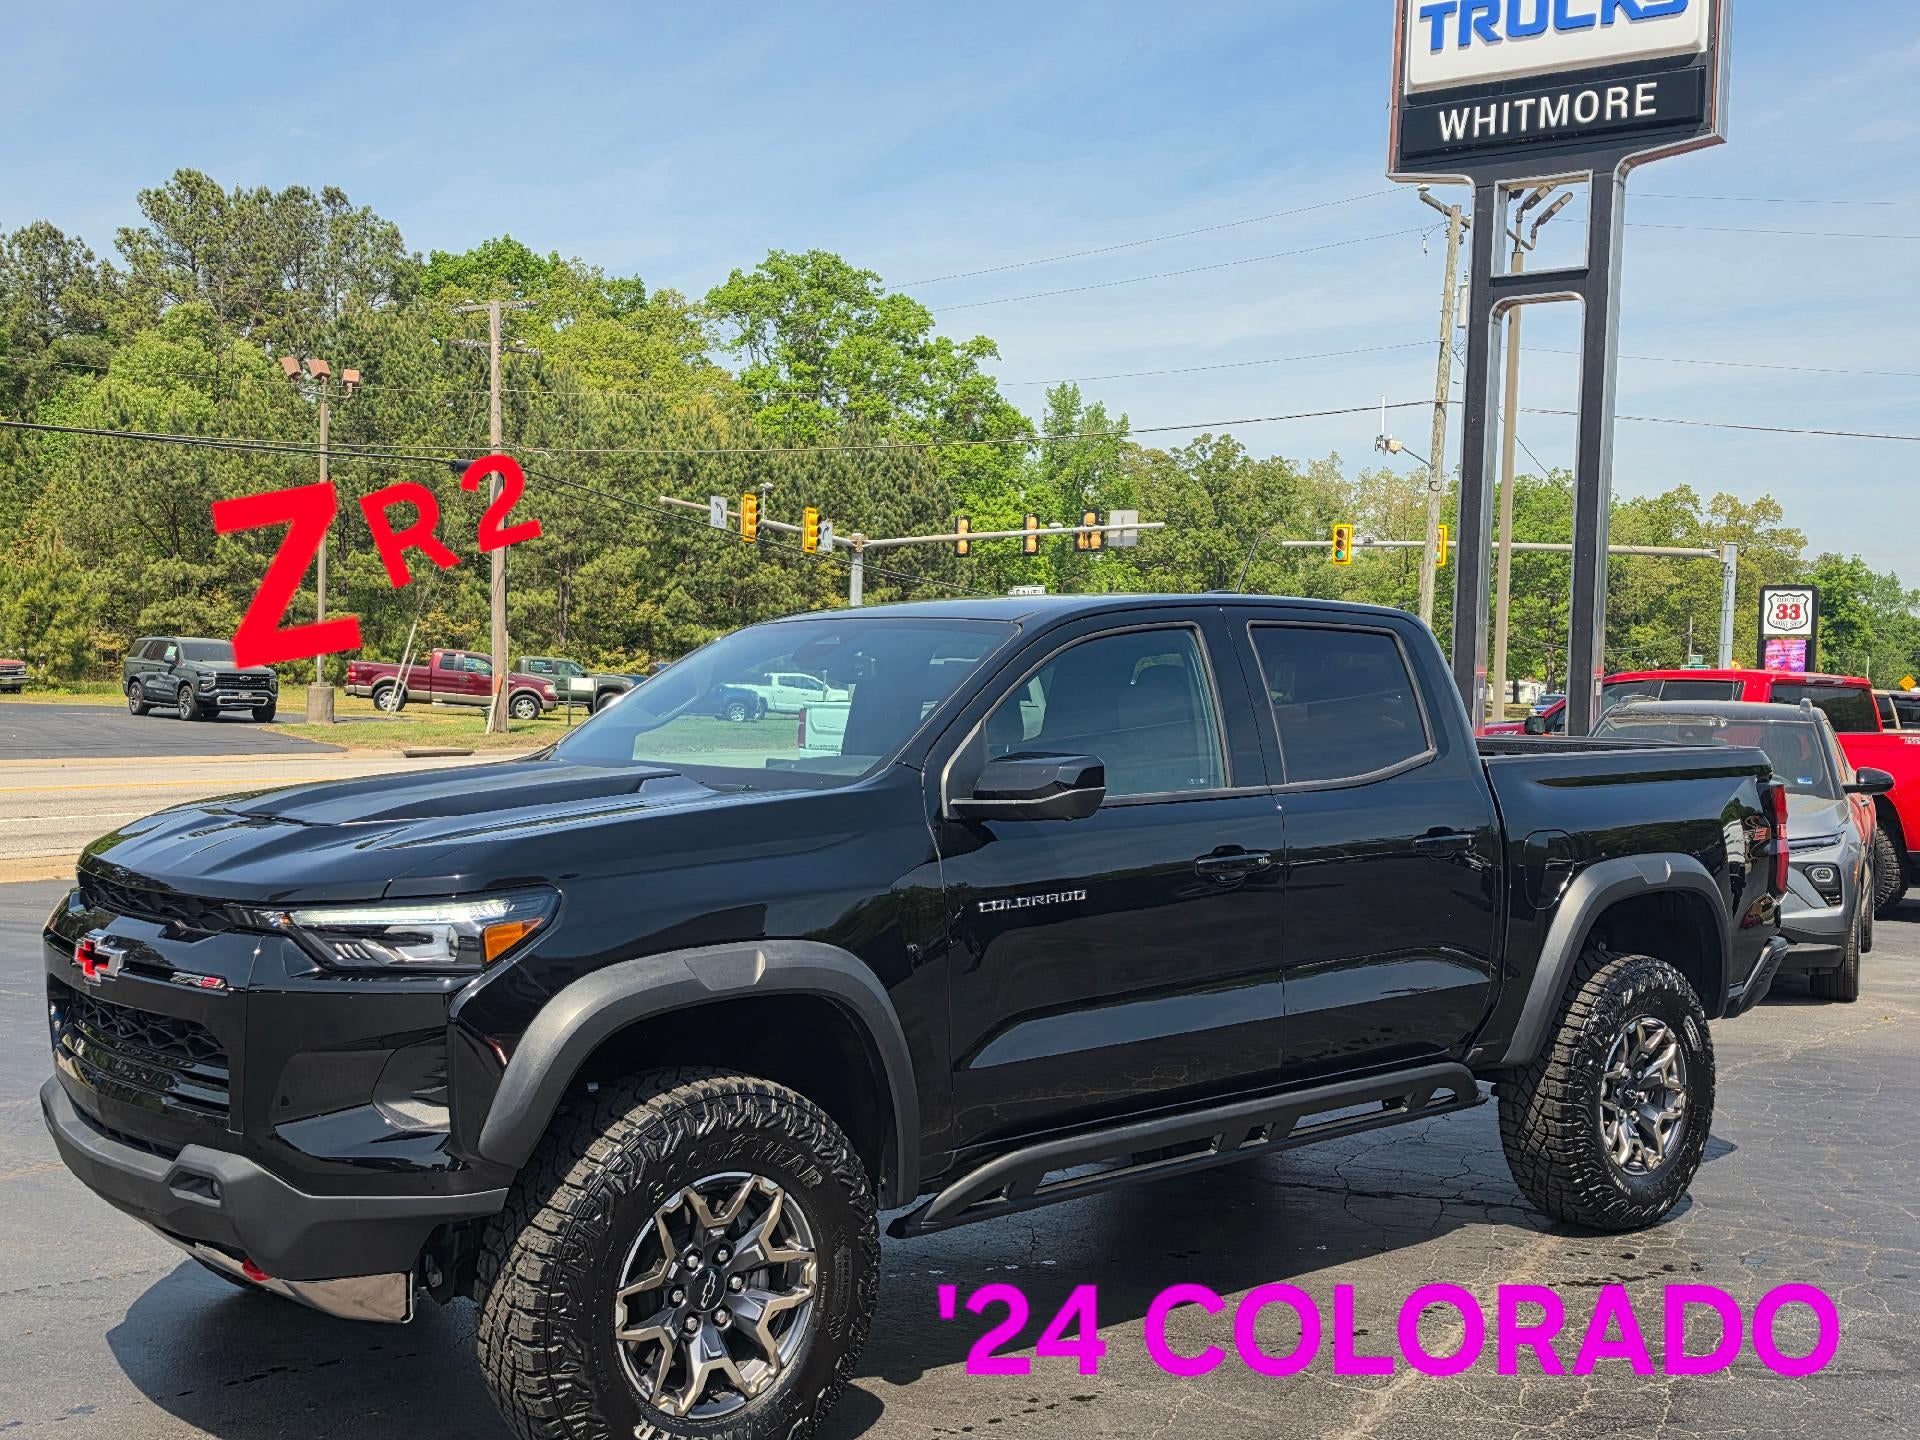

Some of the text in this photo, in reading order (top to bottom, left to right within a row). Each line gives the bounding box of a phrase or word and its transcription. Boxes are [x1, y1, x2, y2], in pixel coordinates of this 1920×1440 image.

[1439, 82, 1657, 142] WHITMORE
[1775, 603, 1801, 620] 33
[979, 889, 1087, 912] COLORADO
